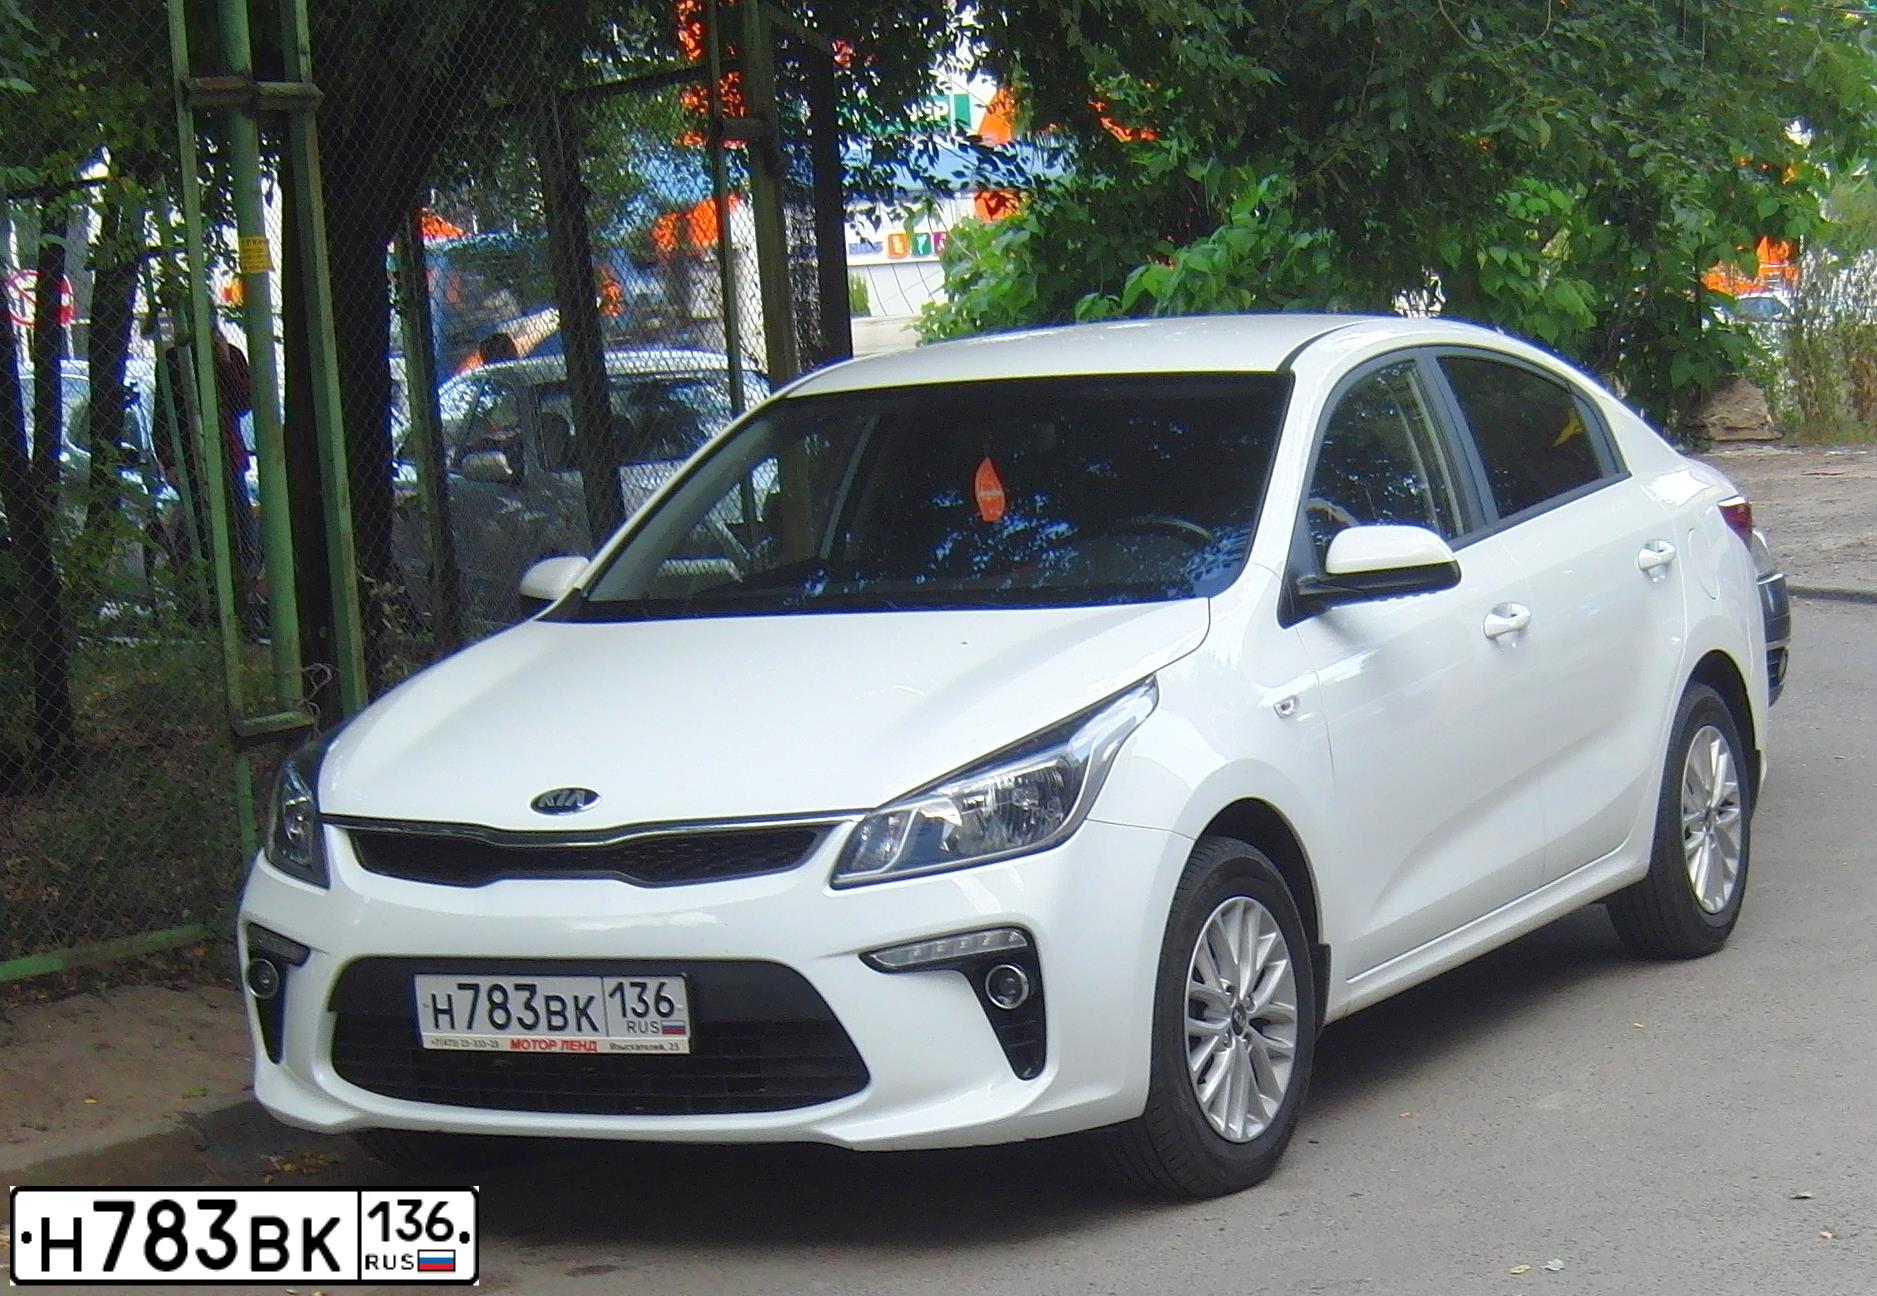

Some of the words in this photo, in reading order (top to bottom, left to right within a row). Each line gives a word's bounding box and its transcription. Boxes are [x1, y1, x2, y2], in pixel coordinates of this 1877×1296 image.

[538, 790, 585, 807] KIA
[608, 981, 675, 1018] 136
[627, 1020, 660, 1034] RUS
[510, 1039, 557, 1050] МОТОР
[561, 1040, 598, 1051] ЛЕНД
